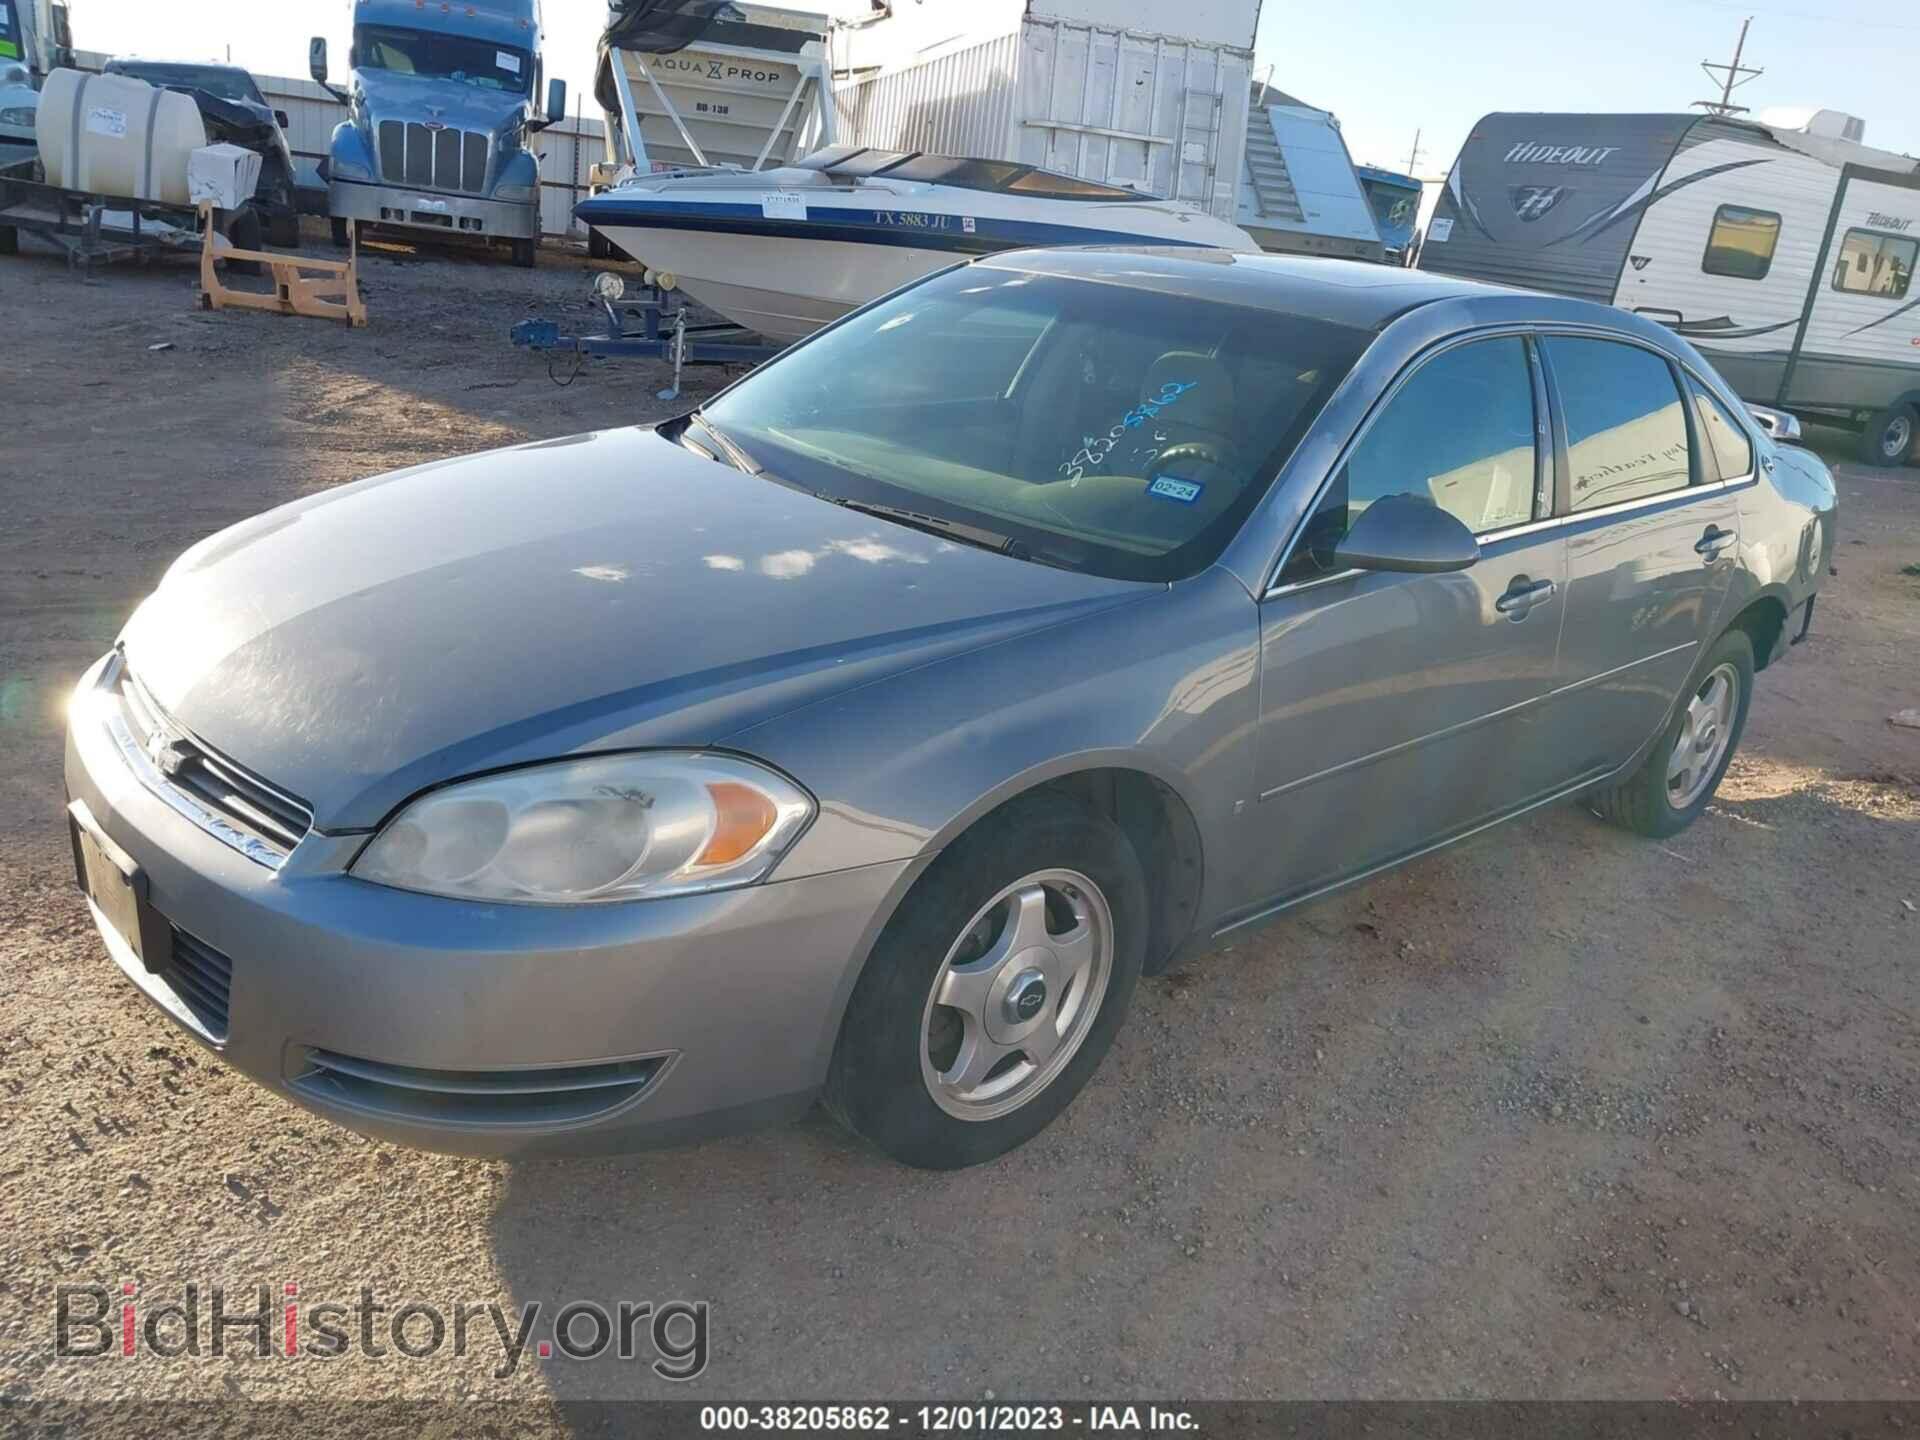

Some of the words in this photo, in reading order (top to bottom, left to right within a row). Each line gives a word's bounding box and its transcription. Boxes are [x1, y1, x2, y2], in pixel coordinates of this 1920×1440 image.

[651, 57, 703, 73] AQUA
[727, 67, 780, 82] PROP
[1503, 141, 1622, 165] HIDEOUT
[873, 211, 896, 225] TX
[899, 213, 929, 228] 5883
[1154, 481, 1195, 497] 02-24
